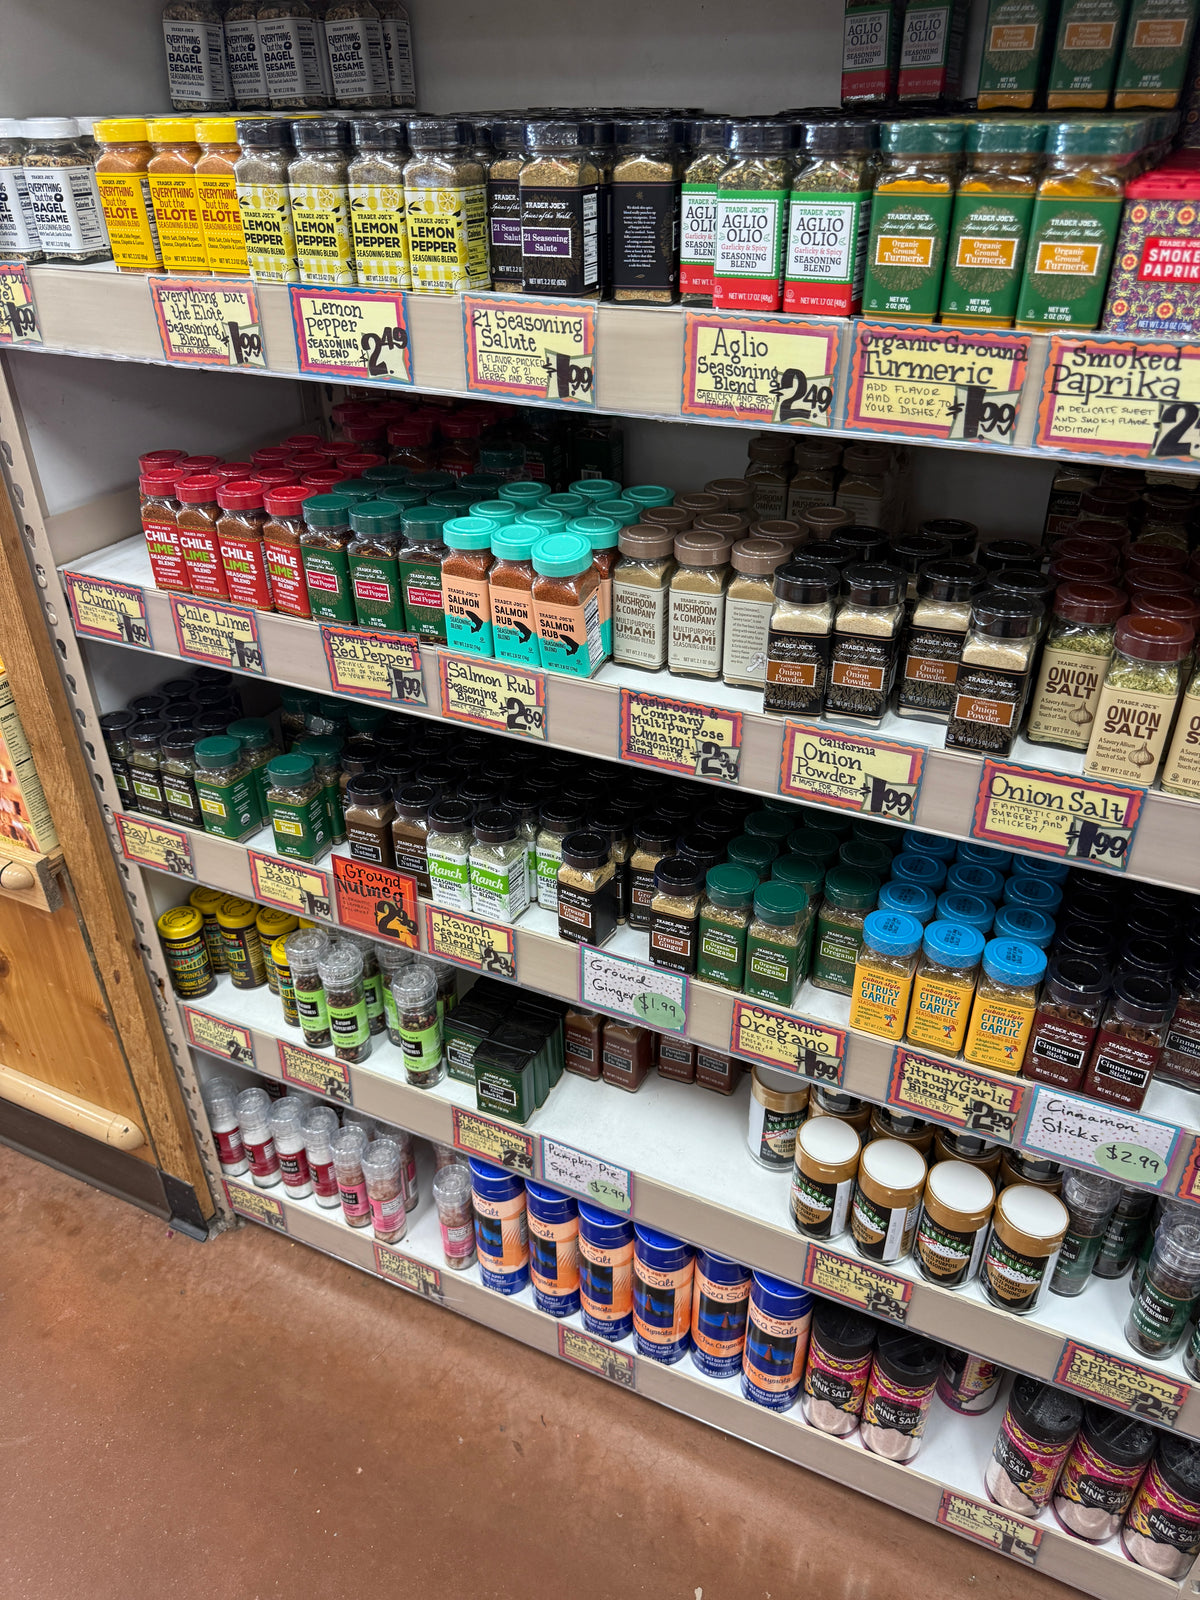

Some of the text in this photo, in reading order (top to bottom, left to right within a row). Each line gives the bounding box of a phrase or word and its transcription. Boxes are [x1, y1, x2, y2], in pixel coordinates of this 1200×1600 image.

[848, 22, 882, 37] AGLIO
[850, 33, 877, 46] OLIO
[168, 53, 202, 64] BAGEL
[170, 64, 203, 74] SESAME
[152, 187, 195, 201] EVERYTHING
[33, 203, 67, 214] BAGEL
[36, 213, 70, 224] SESAME
[156, 209, 198, 221] ELOTE
[354, 222, 398, 236] LEMON
[722, 214, 769, 229] AGLIO
[355, 237, 401, 249] PEPPER
[524, 232, 569, 246] 21 Seasoning
[726, 228, 764, 244] OLIO
[892, 240, 920, 250] Organic
[356, 249, 403, 259] SEASONING BLEND
[535, 243, 558, 254] Salute
[720, 252, 767, 264] SEASONING
[892, 247, 916, 256] Ground
[1149, 248, 1200, 263] SMOKE
[730, 261, 757, 271] BLEND
[883, 253, 924, 265] Turmeric
[1143, 263, 1200, 279] PAPRIK
[158, 286, 246, 306] Everything but
[171, 303, 225, 322] the Elote
[311, 301, 364, 320] Lemon
[165, 319, 222, 341] Seasoning
[304, 317, 358, 338] Pepper
[472, 309, 583, 343] 21 Seasoning
[180, 332, 210, 349] Blend
[308, 339, 359, 354] SEASONING
[481, 328, 538, 353] Salute
[710, 327, 769, 365] Aglio
[859, 329, 1029, 363] Organic Ground
[319, 349, 350, 360] BLEND
[1072, 345, 1182, 373] Smoked
[541, 353, 593, 400] $1.99
[697, 355, 778, 389] Seasoning
[859, 350, 994, 386] Turmeric
[712, 375, 758, 395] Blend
[866, 382, 941, 397] ADD FLAVOR
[1047, 363, 1181, 407] Paprika
[864, 402, 940, 420] YOUR DISHES!
[865, 393, 951, 409] AND COLOR TO
[944, 385, 1016, 441] $1.99
[221, 546, 254, 561] CHILE
[223, 559, 251, 574] LIME
[80, 590, 130, 615] Cumin
[673, 603, 718, 616] MUSHROOM
[175, 601, 251, 632] Chile Lime
[540, 617, 574, 633] SALMON
[673, 614, 717, 627] & COMPANY
[179, 617, 235, 645] Seasoning
[188, 628, 223, 646] Blend
[541, 630, 558, 640] RUB
[673, 625, 716, 636] MULTIPURPOSE
[673, 632, 717, 647] UMAMI
[322, 628, 421, 655] Organic Crushed
[330, 643, 413, 672] Red Pepper
[447, 661, 536, 696] Salmon Rub
[445, 676, 498, 703] Seasoning
[456, 690, 487, 708] Blend
[628, 692, 704, 719] Mushroom
[971, 703, 999, 716] Onion
[640, 704, 706, 730] Company
[967, 711, 1000, 724] Powder
[1106, 705, 1162, 729] ONION
[630, 713, 725, 742] Multipurpose
[632, 725, 691, 749] Umami
[1102, 721, 1159, 741] SALT
[627, 744, 655, 757] Blend
[628, 736, 684, 758] Seasoning
[803, 741, 864, 773] Onion
[818, 737, 877, 758] California
[795, 754, 857, 787] Powder
[989, 775, 1124, 824] Onion Salt
[991, 806, 1063, 830] BURGERS AND
[991, 817, 1045, 834] CHICKEN!
[121, 821, 148, 844] Bay
[263, 857, 307, 878] Organic
[263, 867, 302, 888] Basil
[345, 863, 401, 889] Ground
[334, 873, 405, 909] Nutmeg
[471, 872, 504, 891] Ranch
[434, 922, 495, 950] Seasoning
[441, 913, 491, 939] Ranch
[441, 935, 475, 951] Blend
[658, 935, 683, 946] Ground
[658, 941, 683, 952] Ginger
[590, 959, 652, 988] Ground
[754, 964, 785, 978] Oregano
[592, 978, 637, 1003] Ginger
[638, 992, 676, 1019] $1.99
[752, 1006, 823, 1038] Organic
[980, 1021, 1019, 1038] GARLIC
[981, 1012, 1023, 1030] CITRUSY
[737, 1013, 829, 1053] Oregano
[905, 1053, 952, 1075] Cuban
[1101, 1059, 1145, 1079] Cinnamon
[901, 1061, 1012, 1107] Citrusy Garlic
[1109, 1069, 1131, 1081] Sticks
[898, 1071, 969, 1102] Seasoning
[908, 1083, 948, 1101] Blend
[1047, 1100, 1139, 1133] Cinnamon
[1042, 1118, 1099, 1143] Sticks
[548, 1141, 621, 1180] Pumpkin Pie
[1106, 1145, 1160, 1174] $2.99
[550, 1161, 583, 1183] Spice
[590, 1180, 626, 1204] $2.99
[814, 1259, 896, 1297] Furikake
[771, 1324, 799, 1336] Salt
[1092, 1351, 1147, 1381] Black
[1072, 1353, 1184, 1402] Peppercorns
[875, 1404, 922, 1426] PINK SALT
